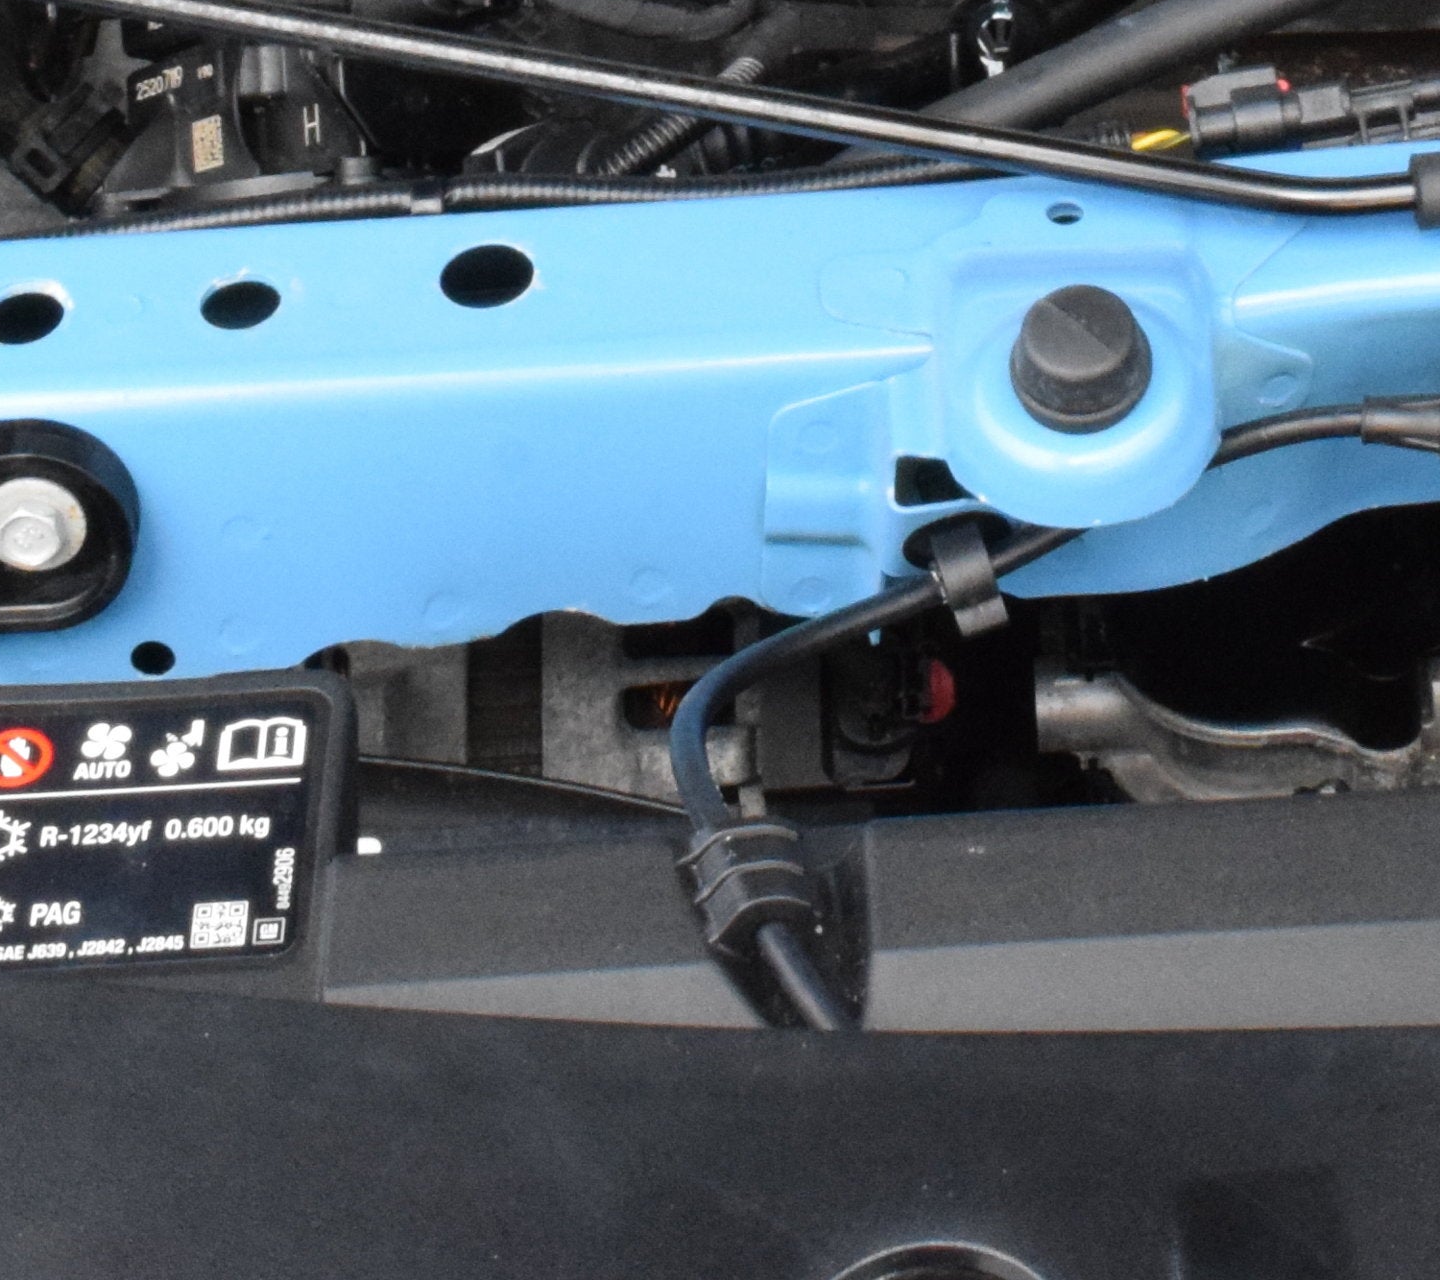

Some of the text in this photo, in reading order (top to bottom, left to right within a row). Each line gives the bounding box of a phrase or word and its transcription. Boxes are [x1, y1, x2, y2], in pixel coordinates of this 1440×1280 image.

[302, 102, 321, 147] H
[73, 759, 132, 781] AUTO
[39, 814, 271, 847] R-1234yf 0.600 kg
[29, 899, 82, 927] PAG
[136, 934, 185, 953] J2845
